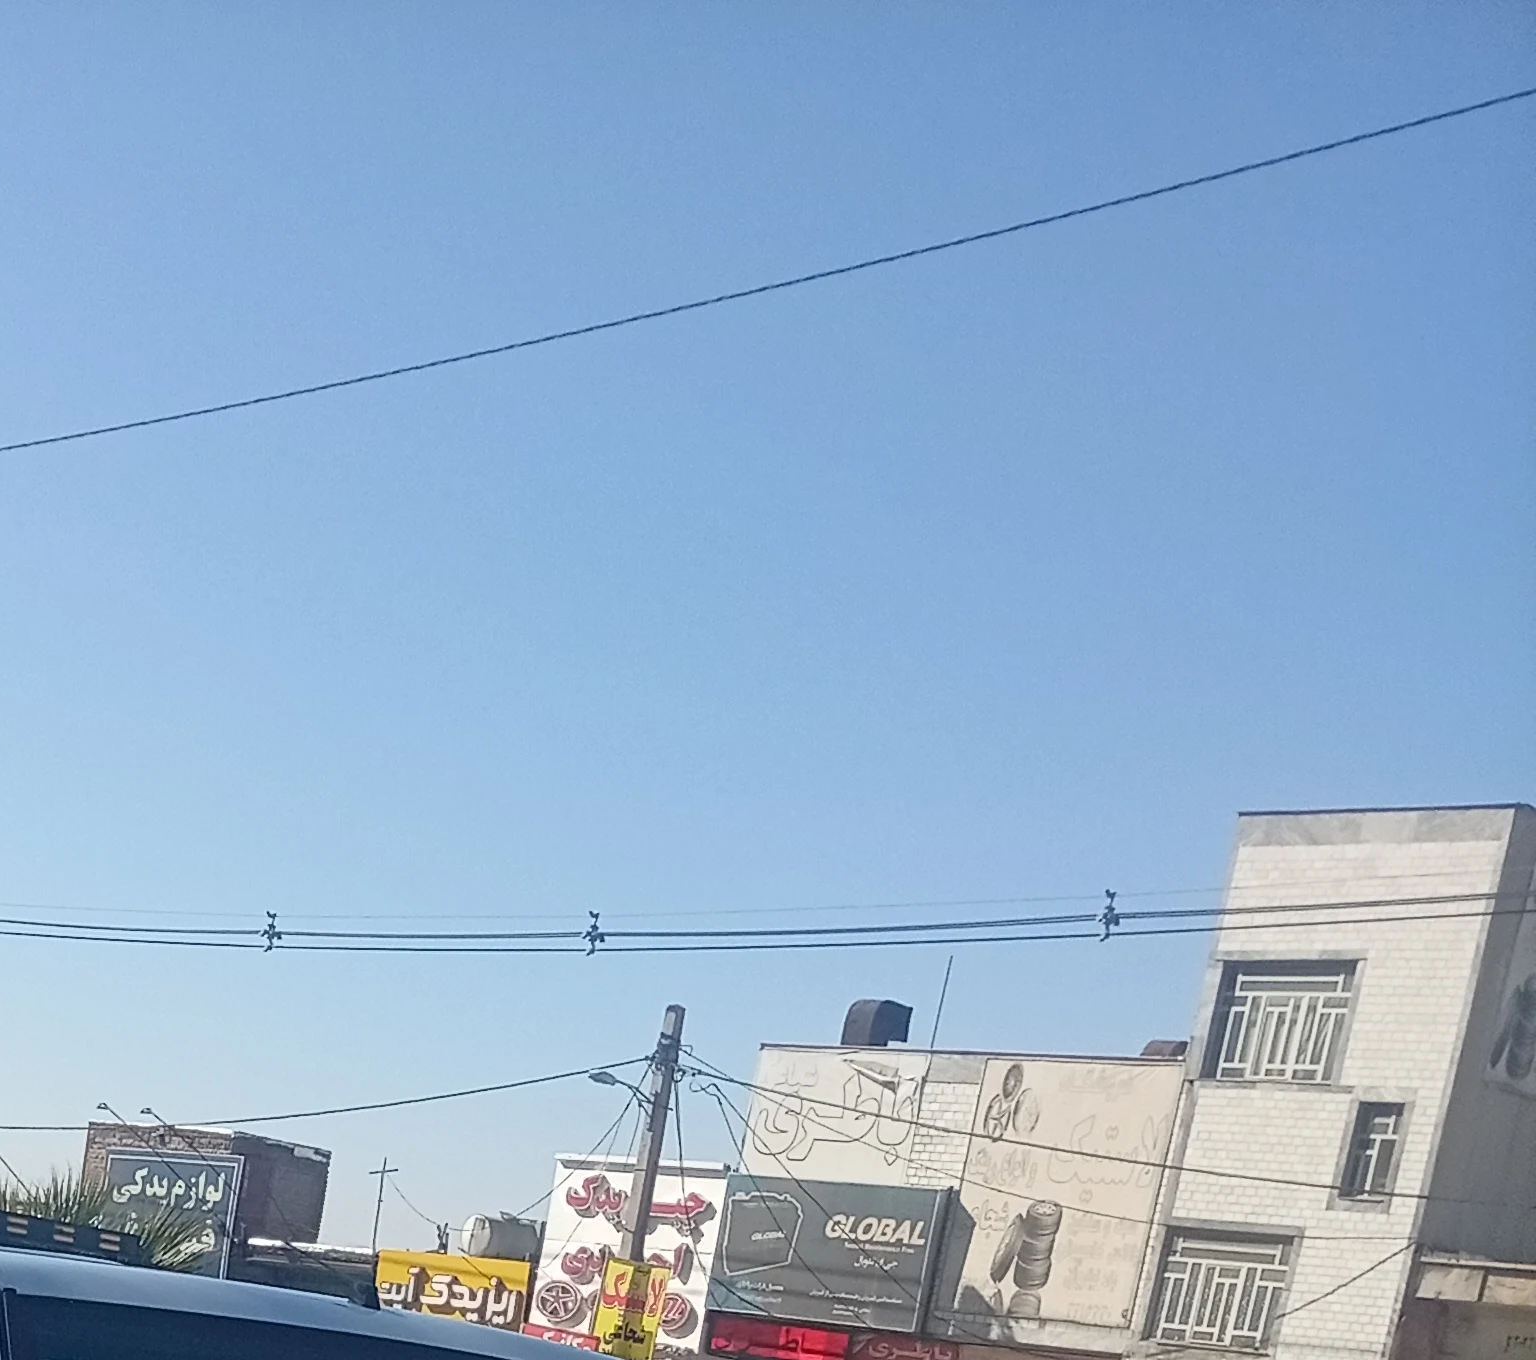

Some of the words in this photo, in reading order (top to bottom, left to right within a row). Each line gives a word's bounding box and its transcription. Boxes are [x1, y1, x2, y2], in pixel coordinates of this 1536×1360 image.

[113, 1167, 169, 1205] یدکی
[170, 1170, 226, 1211] لوازم
[825, 1214, 927, 1246] GLOBAL
